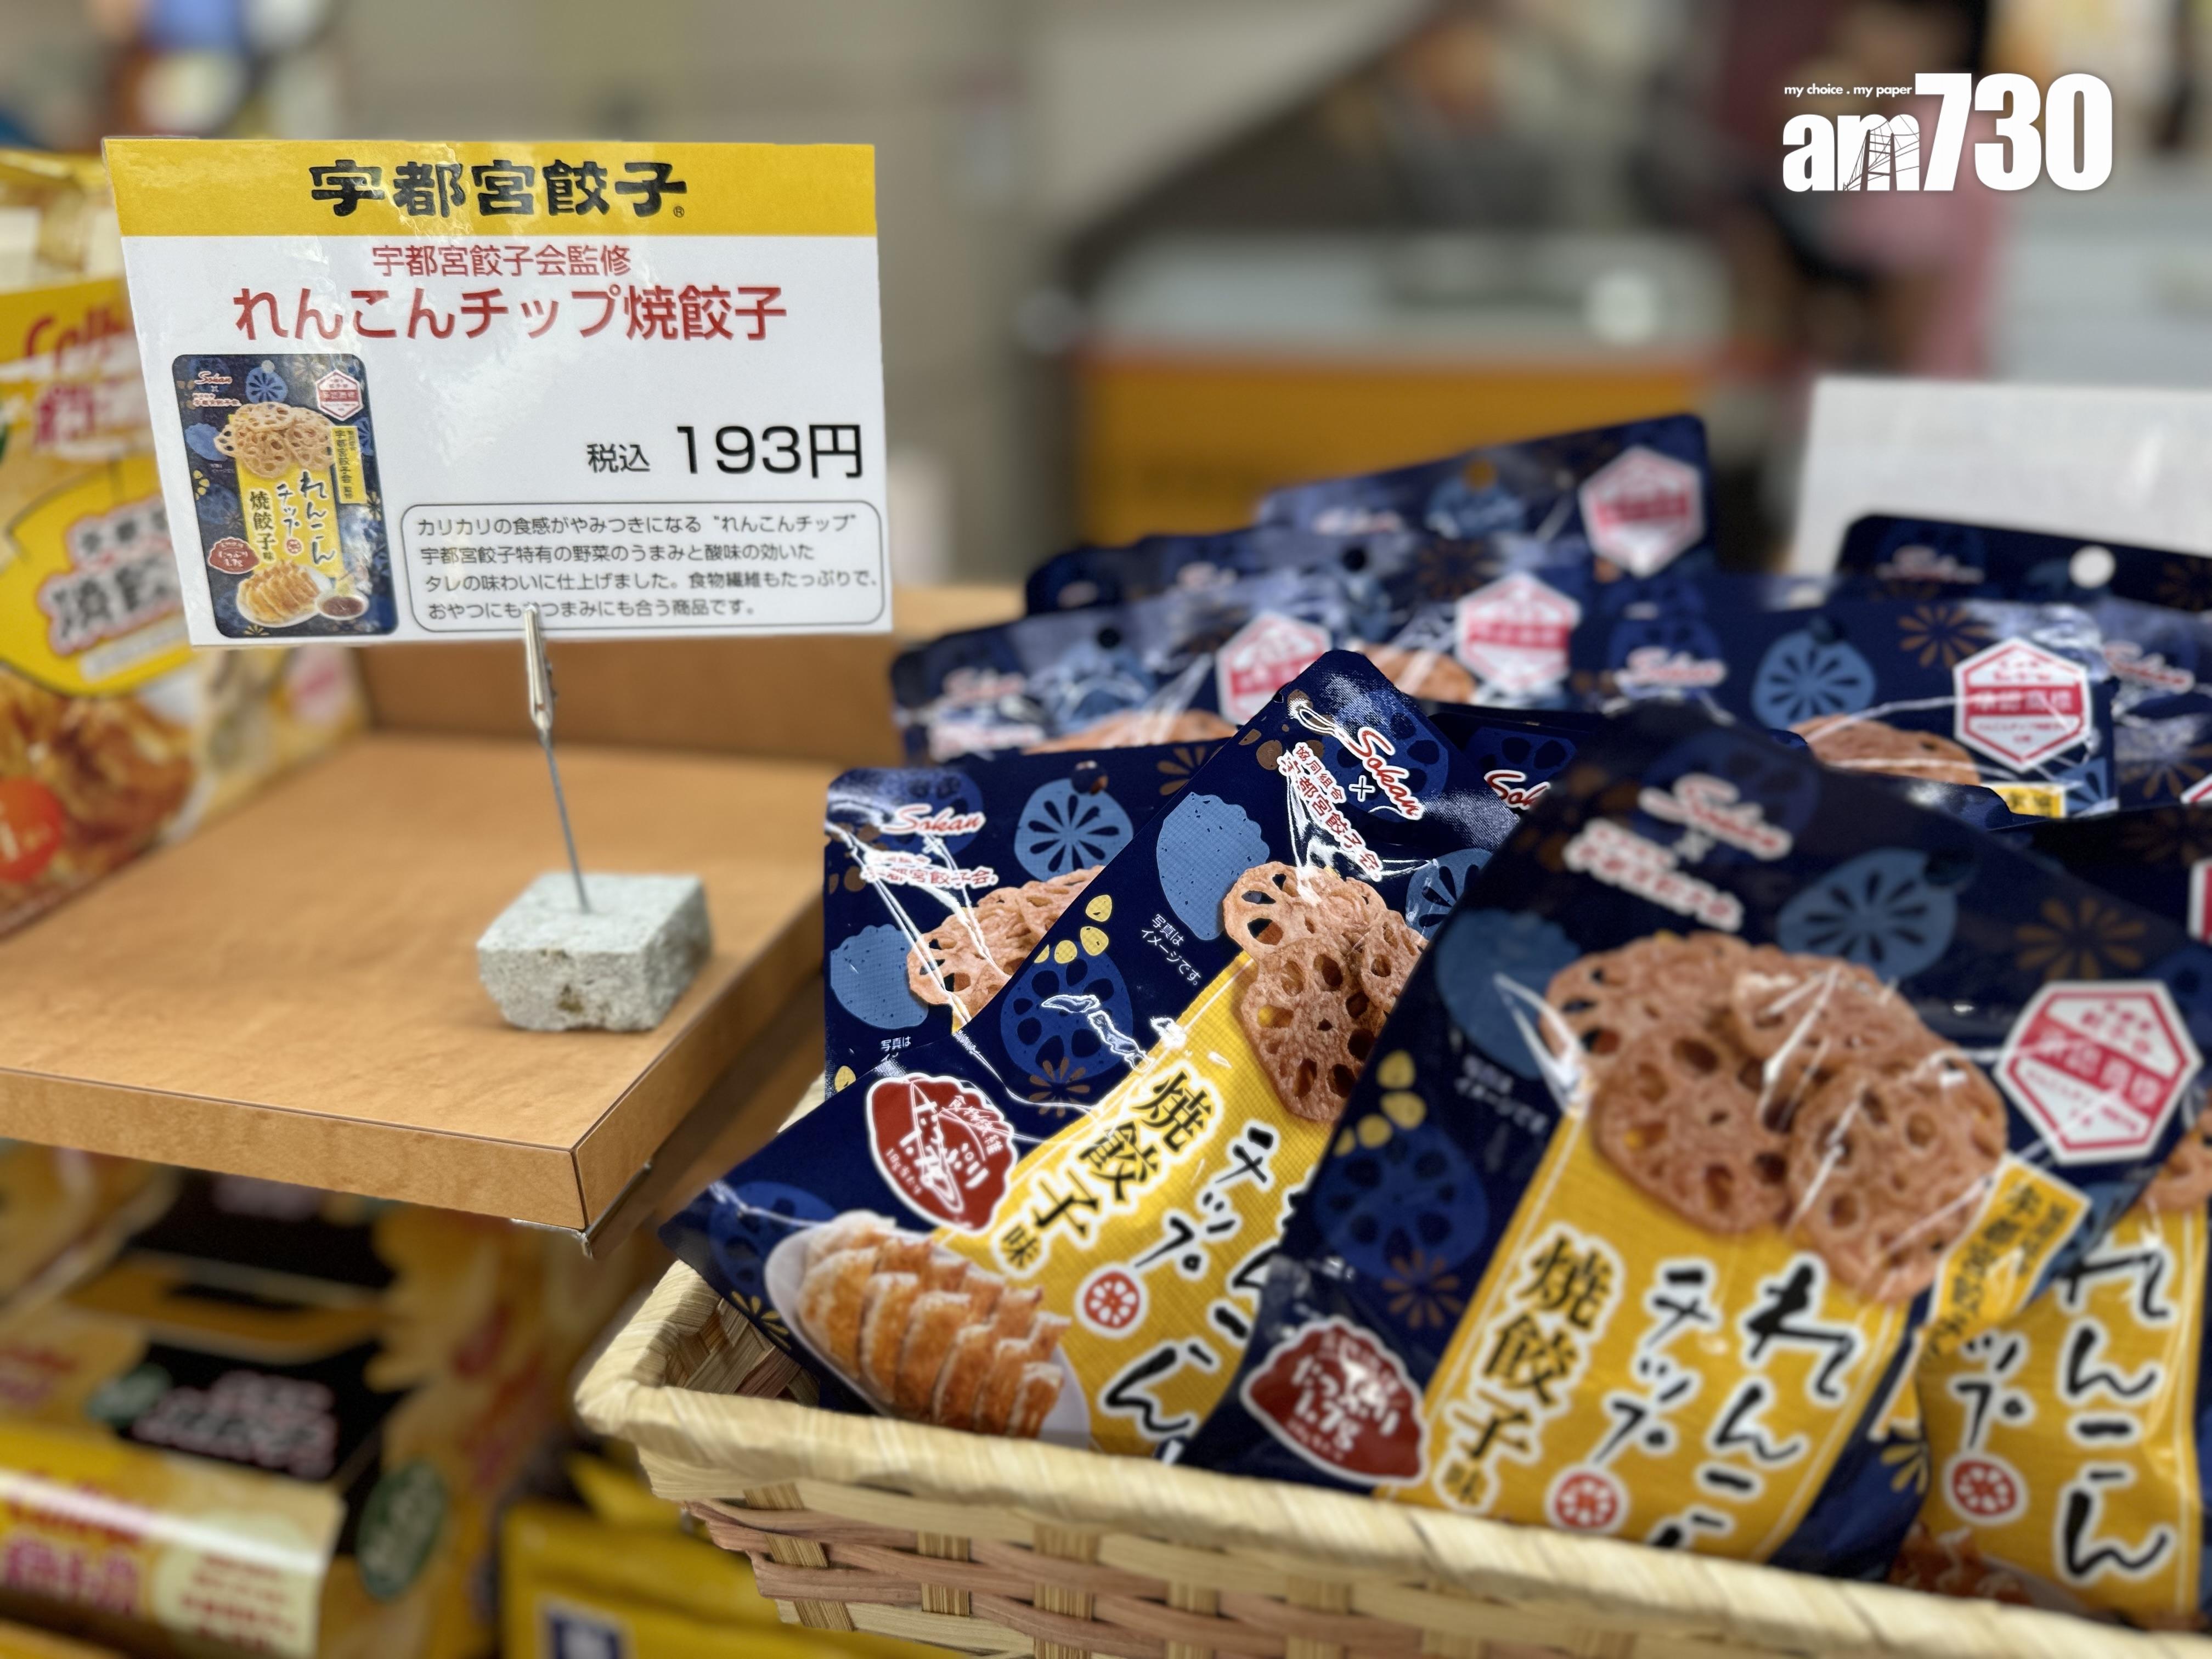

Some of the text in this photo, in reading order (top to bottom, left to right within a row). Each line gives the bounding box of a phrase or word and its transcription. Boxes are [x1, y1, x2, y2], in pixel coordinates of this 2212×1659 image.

[373, 244, 631, 277] 宇都宮餃子会監修
[233, 285, 787, 341] れんこんチップ焼餃子
[587, 424, 864, 479] 税込 193円
[420, 544, 815, 565] 宇都宮餃子特有の野菜のうまみと酸味の効いた
[428, 598, 755, 621] おやつにもつまみにも合う商品です。
[1295, 744, 1344, 801] 協同組合
[1342, 729, 1421, 817] Sokan
[1152, 913, 1184, 946] 写真は
[881, 1035, 911, 1052] 写真は
[1003, 1071, 1215, 1271] 焼餃子味
[1135, 1127, 1274, 1273] チップ
[1442, 1234, 1611, 1505] 焼餃子味
[1593, 1268, 1712, 1465] チップ
